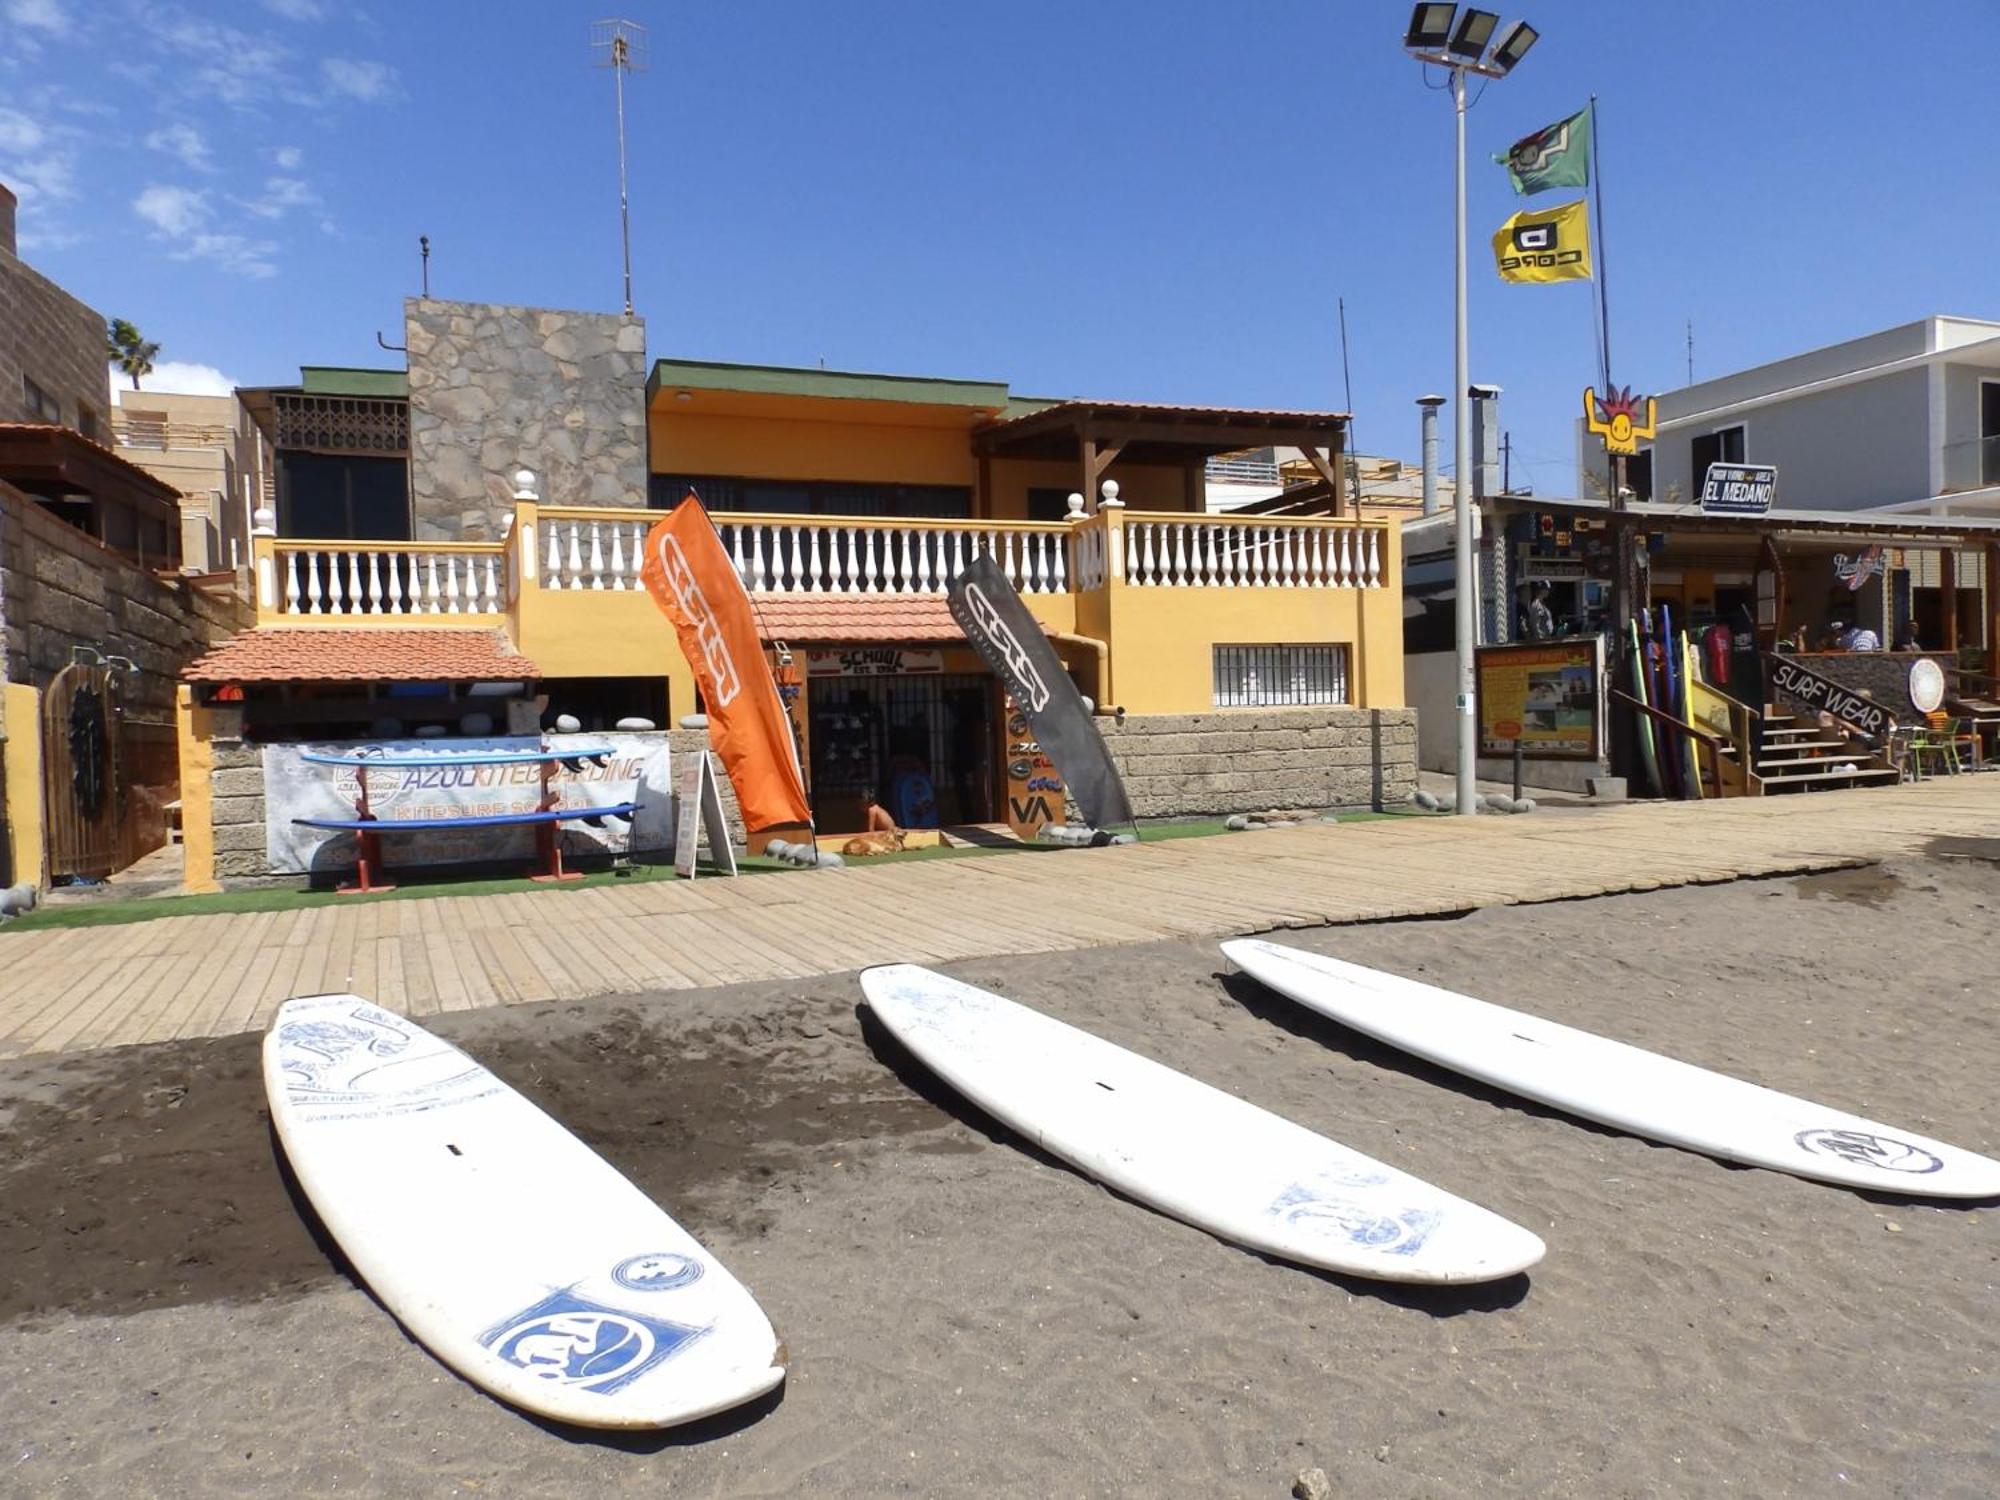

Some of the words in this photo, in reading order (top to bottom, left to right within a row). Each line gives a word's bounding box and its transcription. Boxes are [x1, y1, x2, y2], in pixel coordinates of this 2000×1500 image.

[1705, 481, 1720, 501] EL
[839, 649, 904, 671] SCHOOL
[1772, 665, 1828, 700] SURF
[1824, 687, 1882, 732] WEAR
